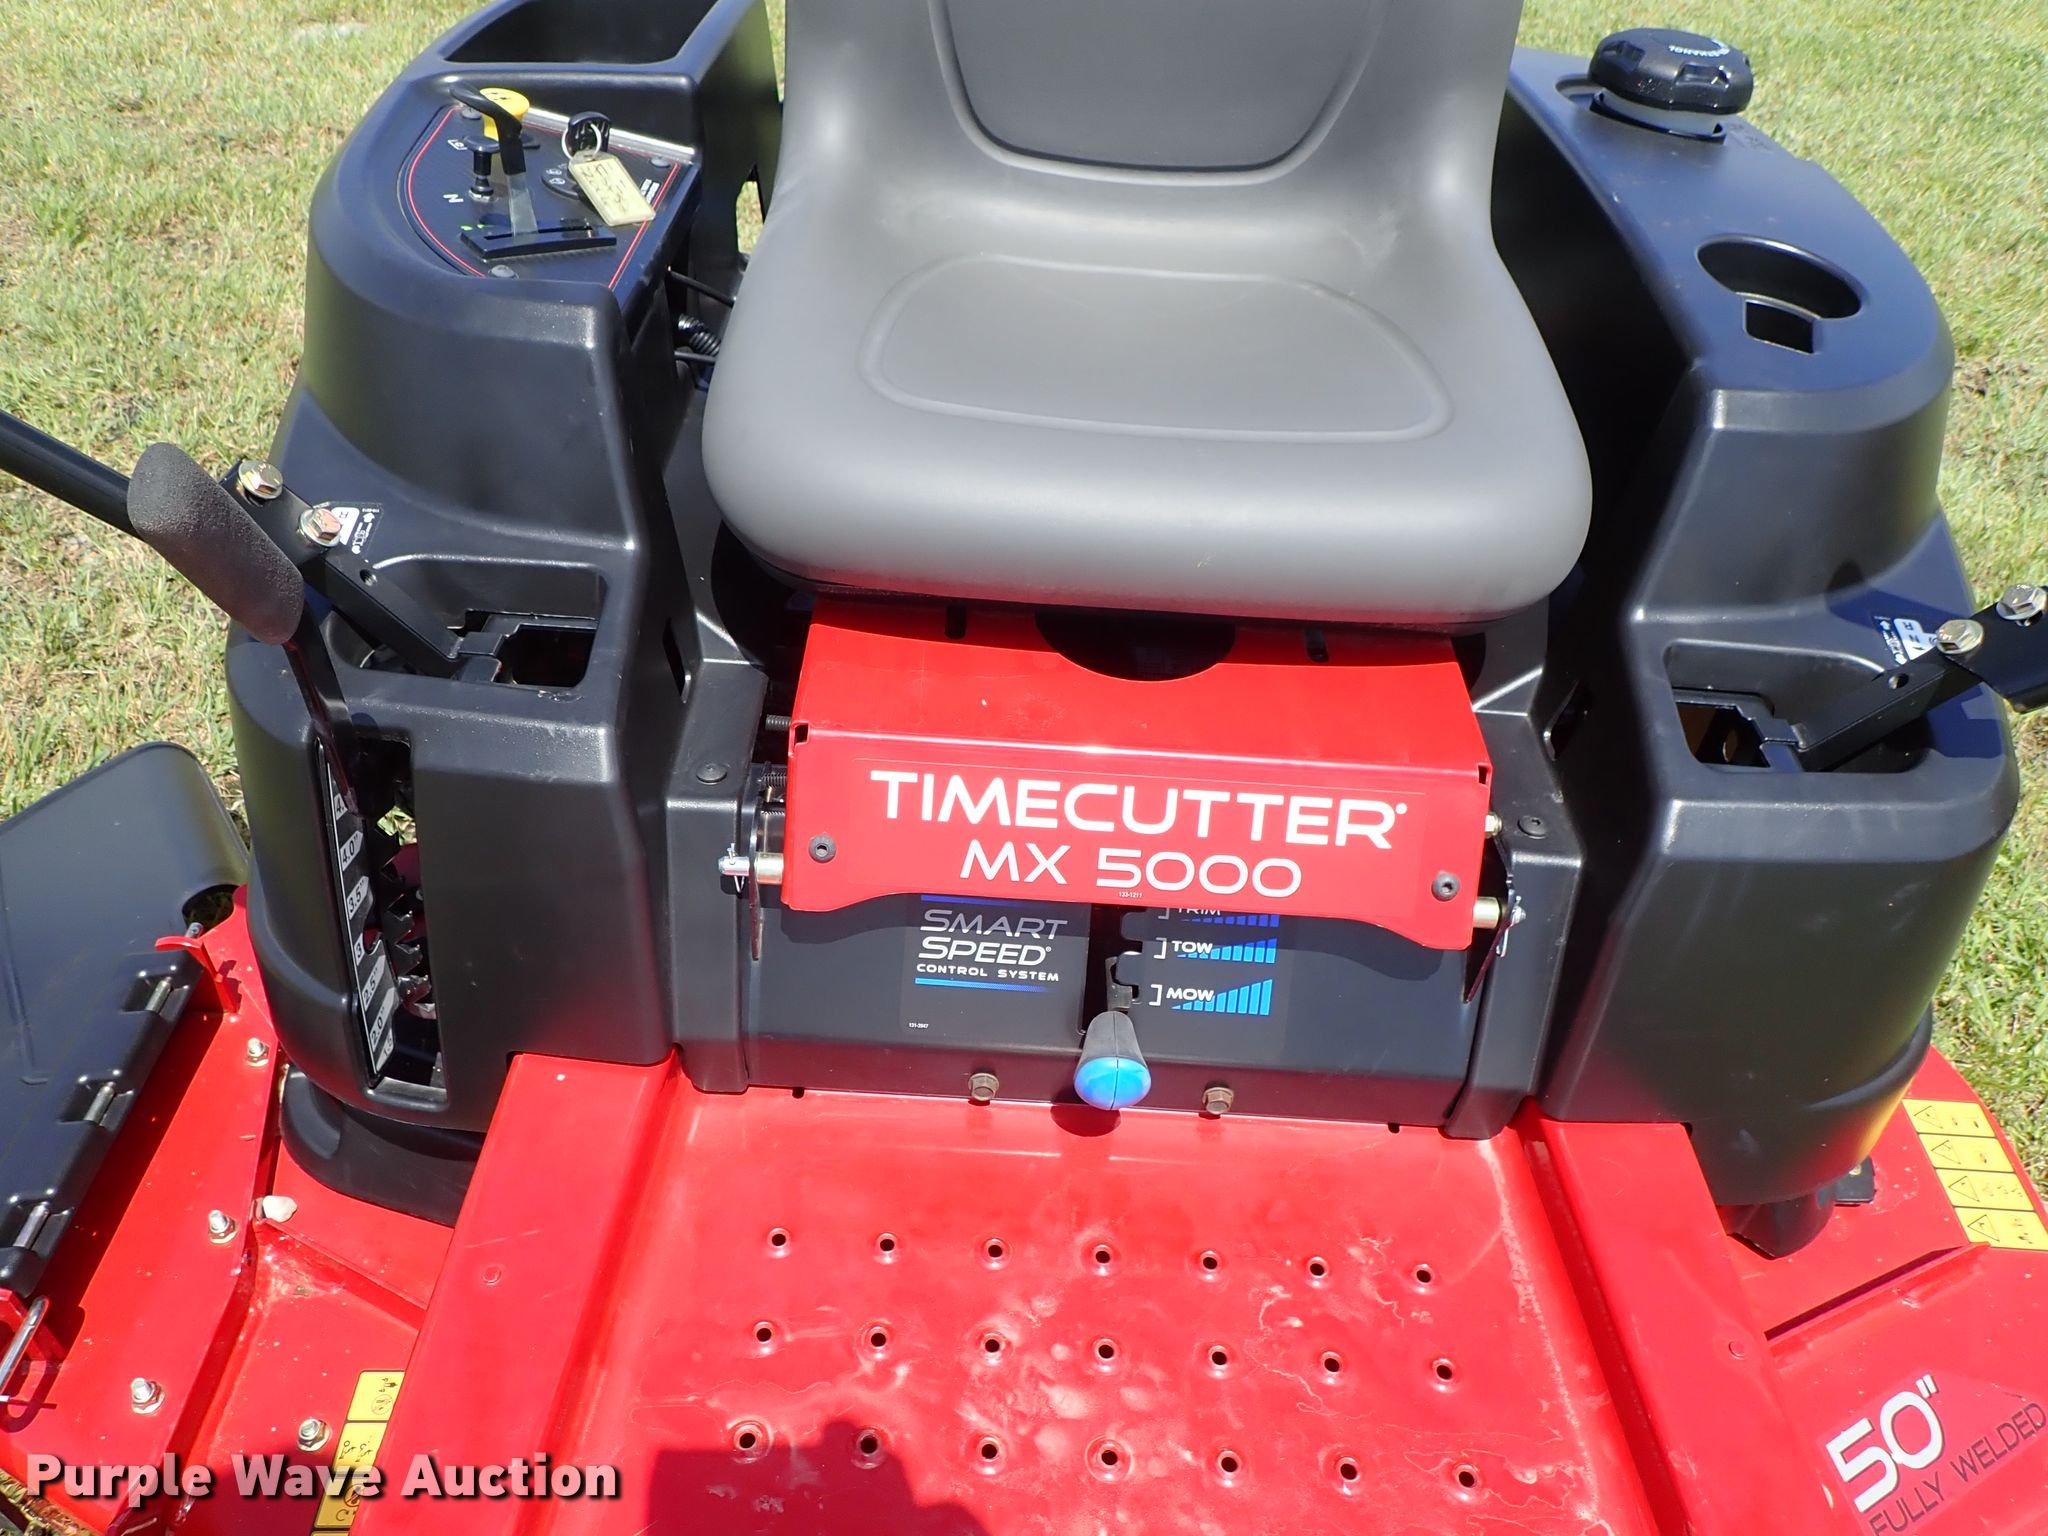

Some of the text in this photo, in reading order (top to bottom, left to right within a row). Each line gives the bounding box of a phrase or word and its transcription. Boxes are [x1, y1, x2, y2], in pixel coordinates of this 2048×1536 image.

[960, 839, 1302, 898] MX 5000
[920, 909, 1068, 940] SMART
[1171, 940, 1214, 954] TOW
[916, 963, 1060, 982] CONTROL SYSTEM
[1166, 987, 1215, 1002] MOW
[1869, 1403, 2047, 1536] FULLY WELDED
